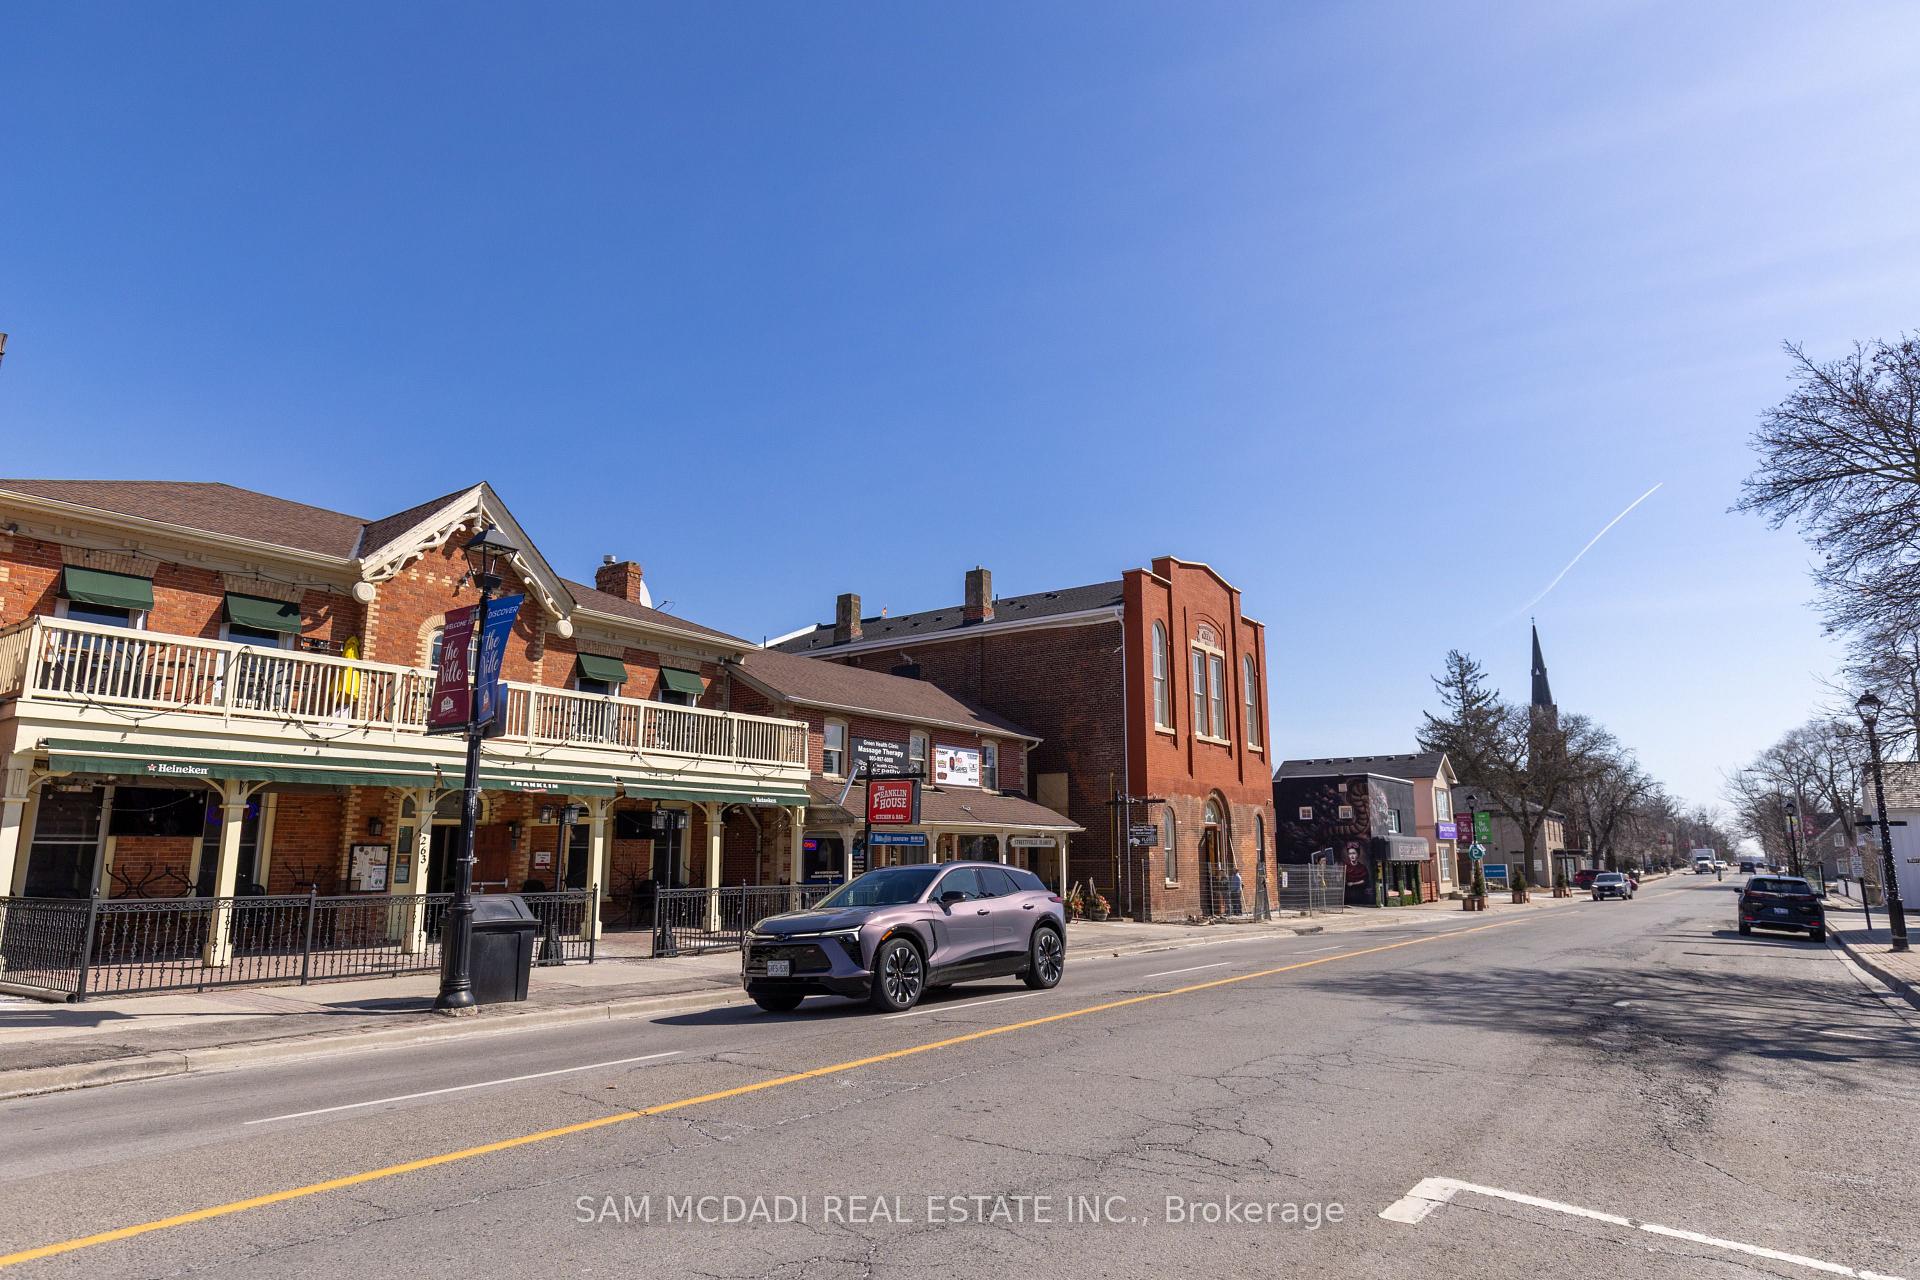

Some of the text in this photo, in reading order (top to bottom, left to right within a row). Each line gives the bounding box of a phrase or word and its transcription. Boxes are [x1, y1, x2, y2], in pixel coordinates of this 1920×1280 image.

[488, 605, 519, 619] DISCOVER
[485, 629, 500, 651] the
[444, 641, 460, 660] the
[481, 651, 499, 675] Ville
[440, 661, 464, 686] Ville
[857, 745, 904, 758] Massage Therapy
[158, 763, 209, 774] Heineken
[510, 780, 559, 789] FRANKLIN
[873, 789, 907, 809] FRANKLIN
[880, 797, 907, 809] HOUSE
